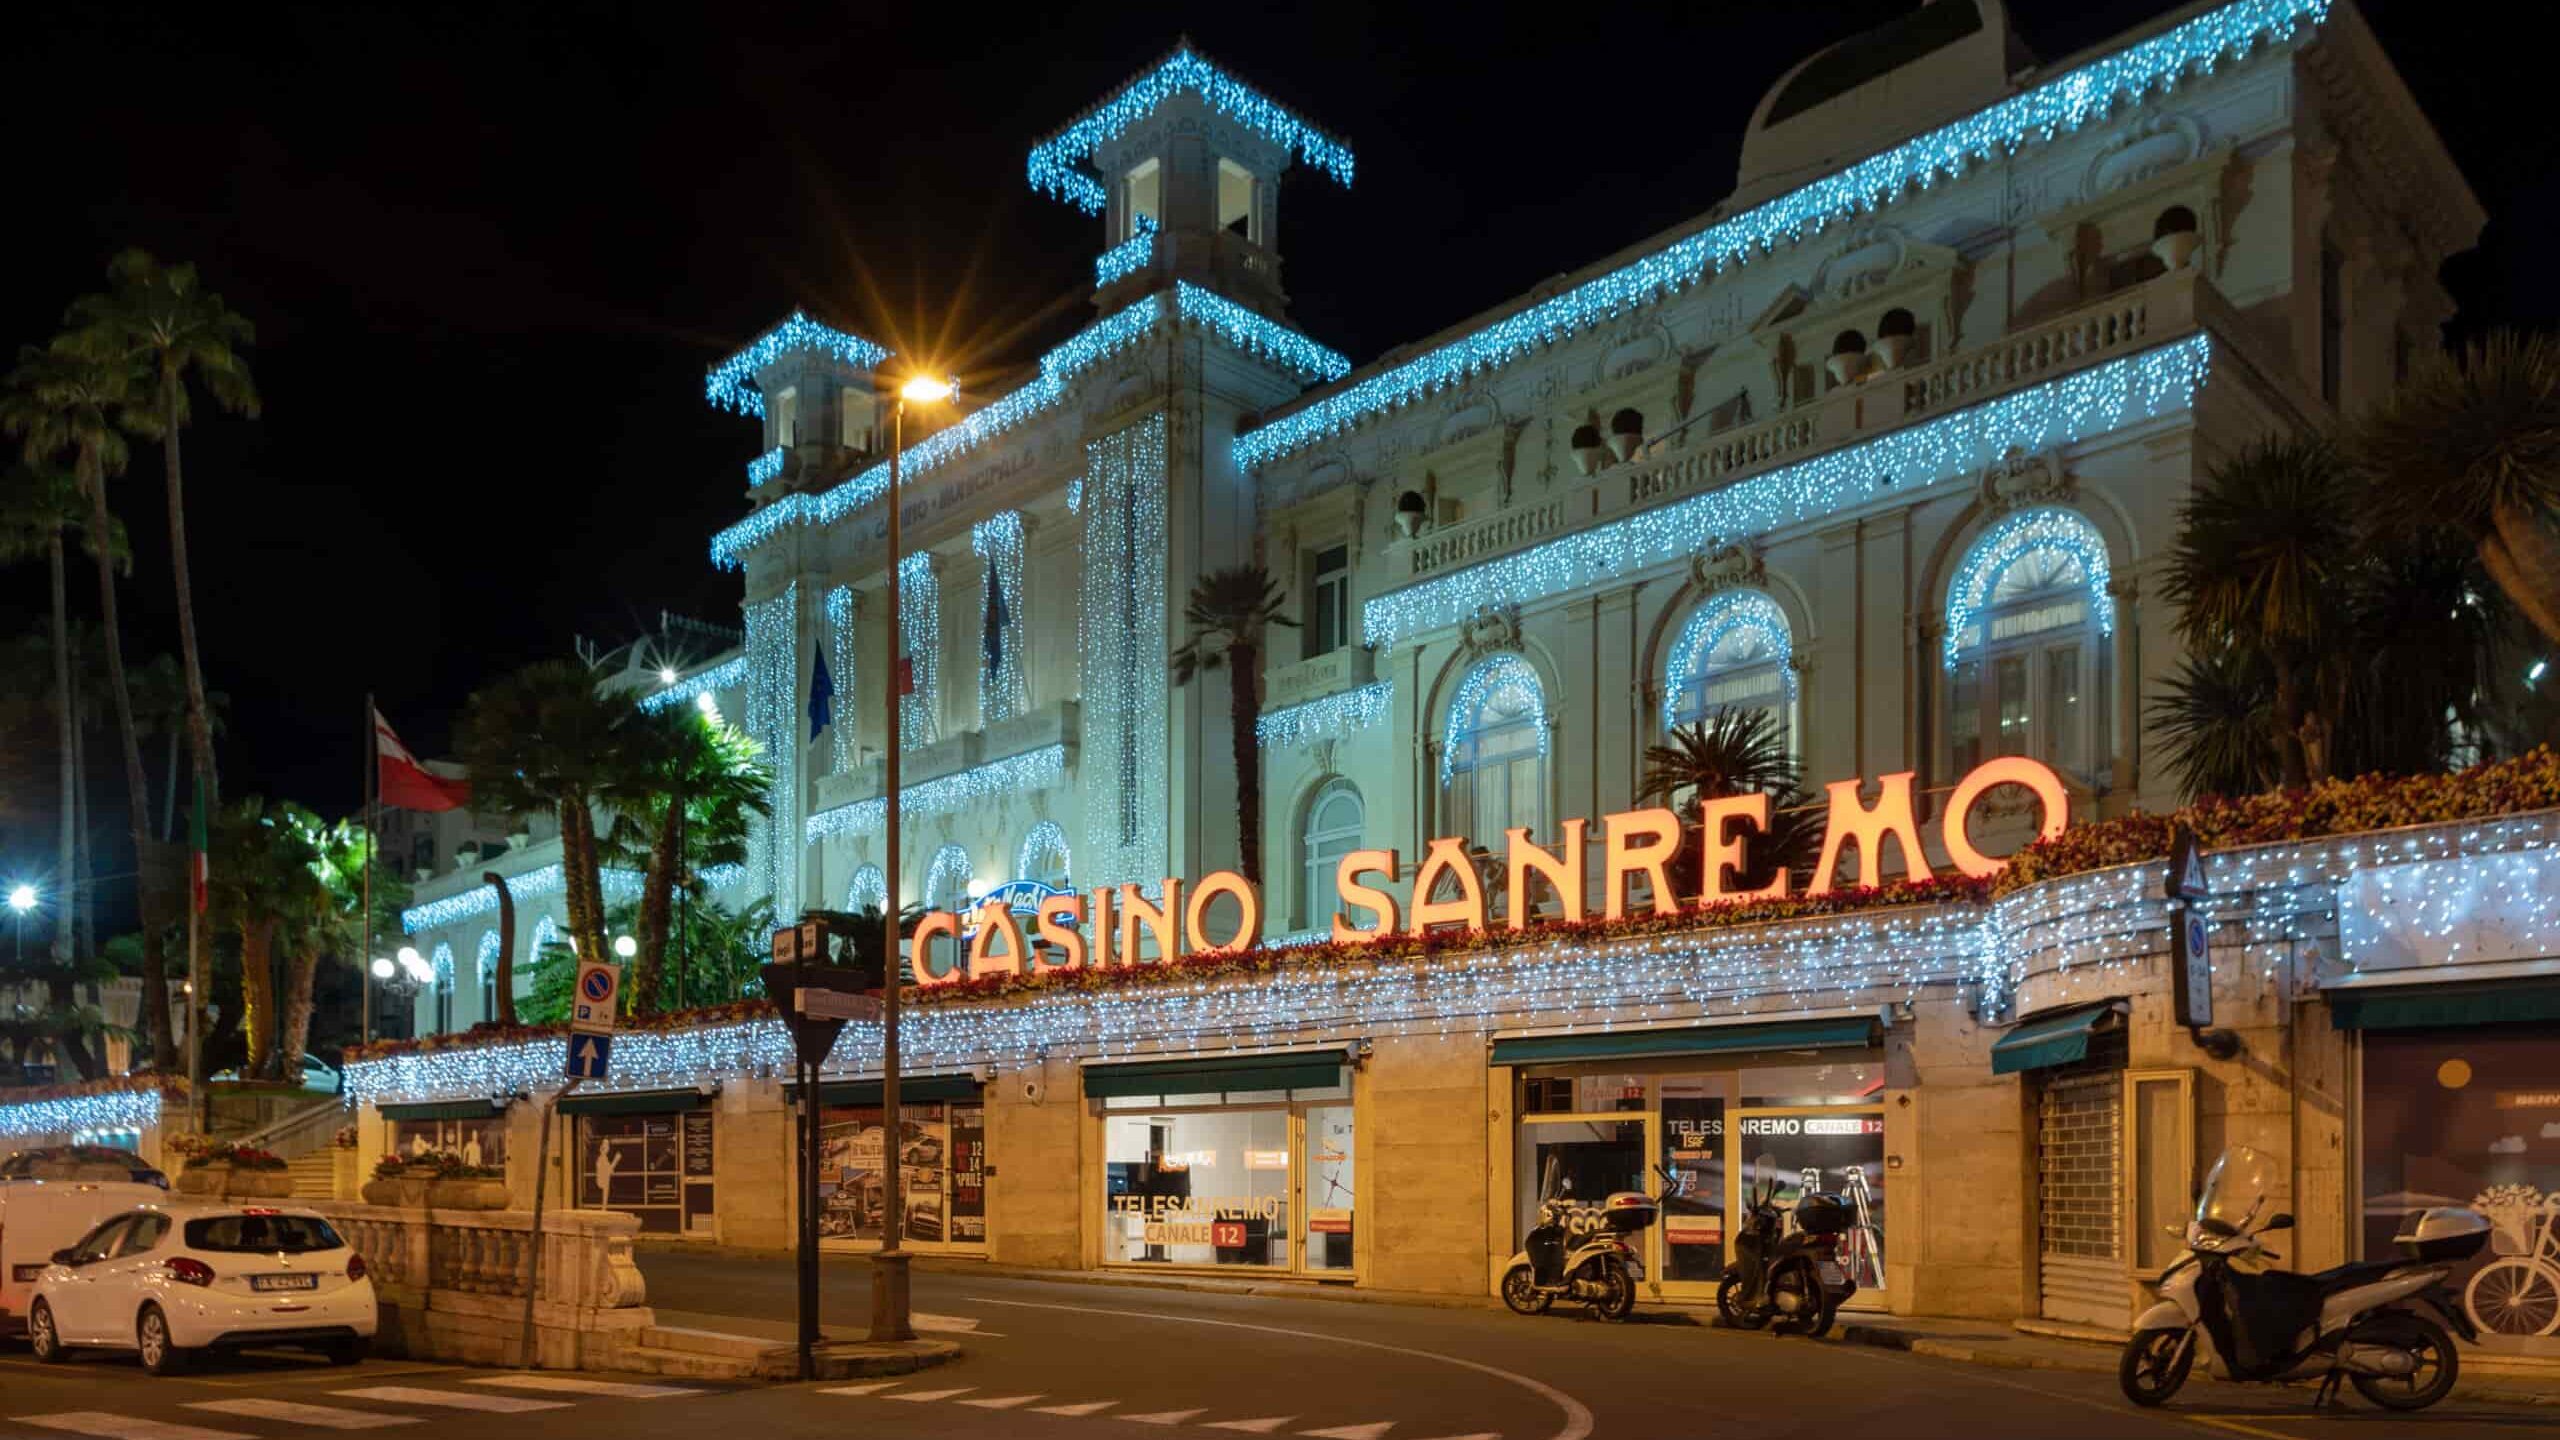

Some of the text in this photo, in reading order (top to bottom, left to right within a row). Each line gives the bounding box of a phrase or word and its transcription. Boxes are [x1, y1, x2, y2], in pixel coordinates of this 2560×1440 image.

[911, 756, 2068, 985] CASINO SANREMO
[1668, 1119, 1883, 1135] TELESNREMO CANALE 12
[972, 1141, 983, 1156] 12
[970, 1157, 981, 1172] 14
[1114, 1195, 1280, 1221] TELESANREMO
[1146, 1225, 1238, 1244] CANALE 12
